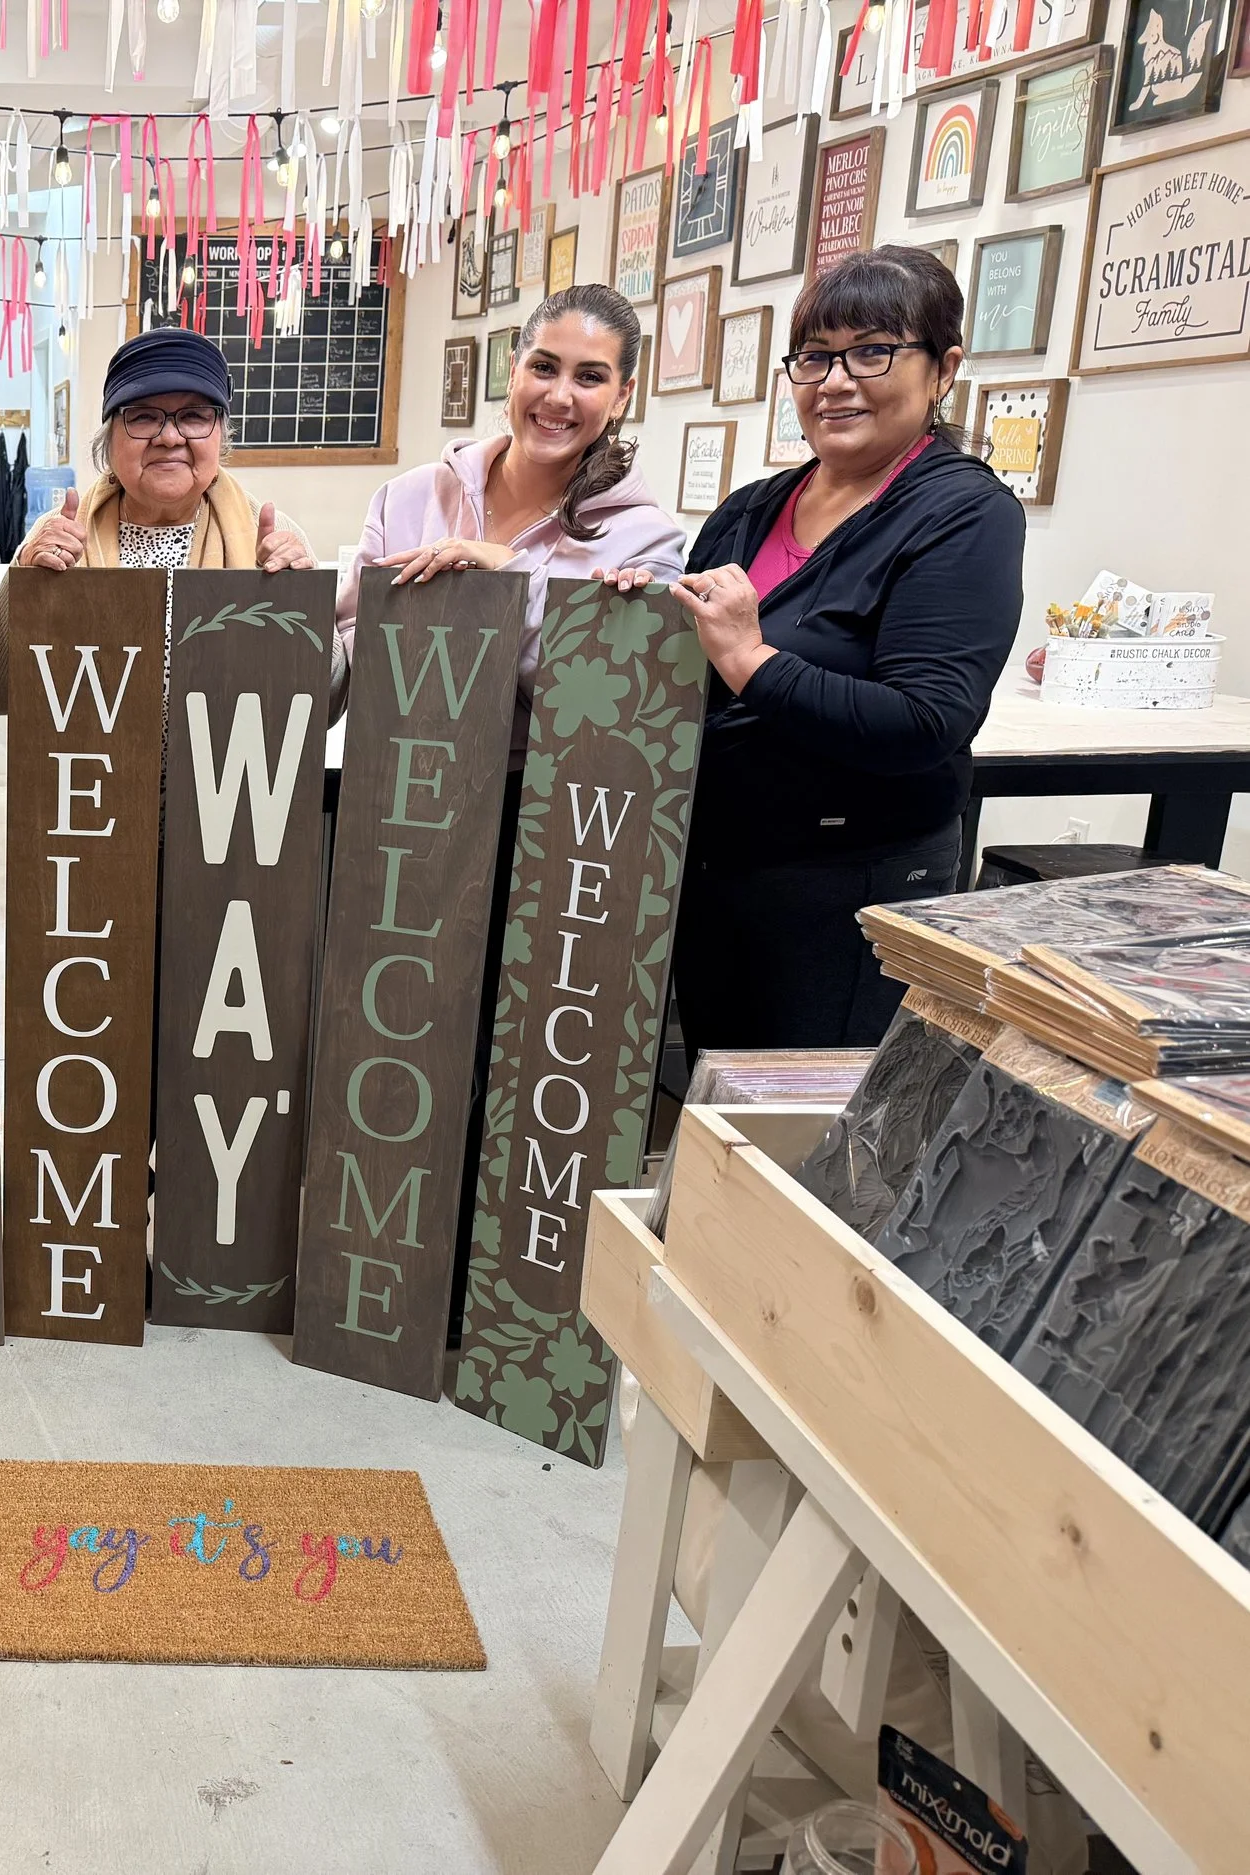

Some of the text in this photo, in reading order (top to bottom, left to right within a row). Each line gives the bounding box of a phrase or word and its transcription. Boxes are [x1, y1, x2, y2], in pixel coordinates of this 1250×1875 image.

[827, 145, 870, 176] MERLOT
[825, 168, 868, 193] PINOT GRIS
[623, 178, 660, 215] PATIOS
[822, 195, 864, 219] PINOT NOIR
[1127, 172, 1244, 228] HOME SWEET HOME
[820, 212, 863, 240] MALBEC
[1162, 197, 1195, 238] The
[817, 235, 861, 254] CHARDONNAY
[990, 250, 1008, 263] YOU
[989, 265, 1021, 280] BELONG
[987, 284, 1007, 296] WITH
[1131, 295, 1209, 336] Family
[995, 424, 1023, 446] hello
[992, 448, 1032, 465] SPRING
[1116, 647, 1211, 659] RUSTIC CHALK DECOR
[29, 644, 142, 1321] WELCOME
[330, 623, 498, 1343] WELCOME
[520, 782, 636, 1273] WELCOME
[904, 993, 928, 1014] IRON
[929, 1009, 970, 1036] ORCHID
[1139, 1141, 1179, 1170] IRON
[19, 1499, 404, 1604] yay it's you
